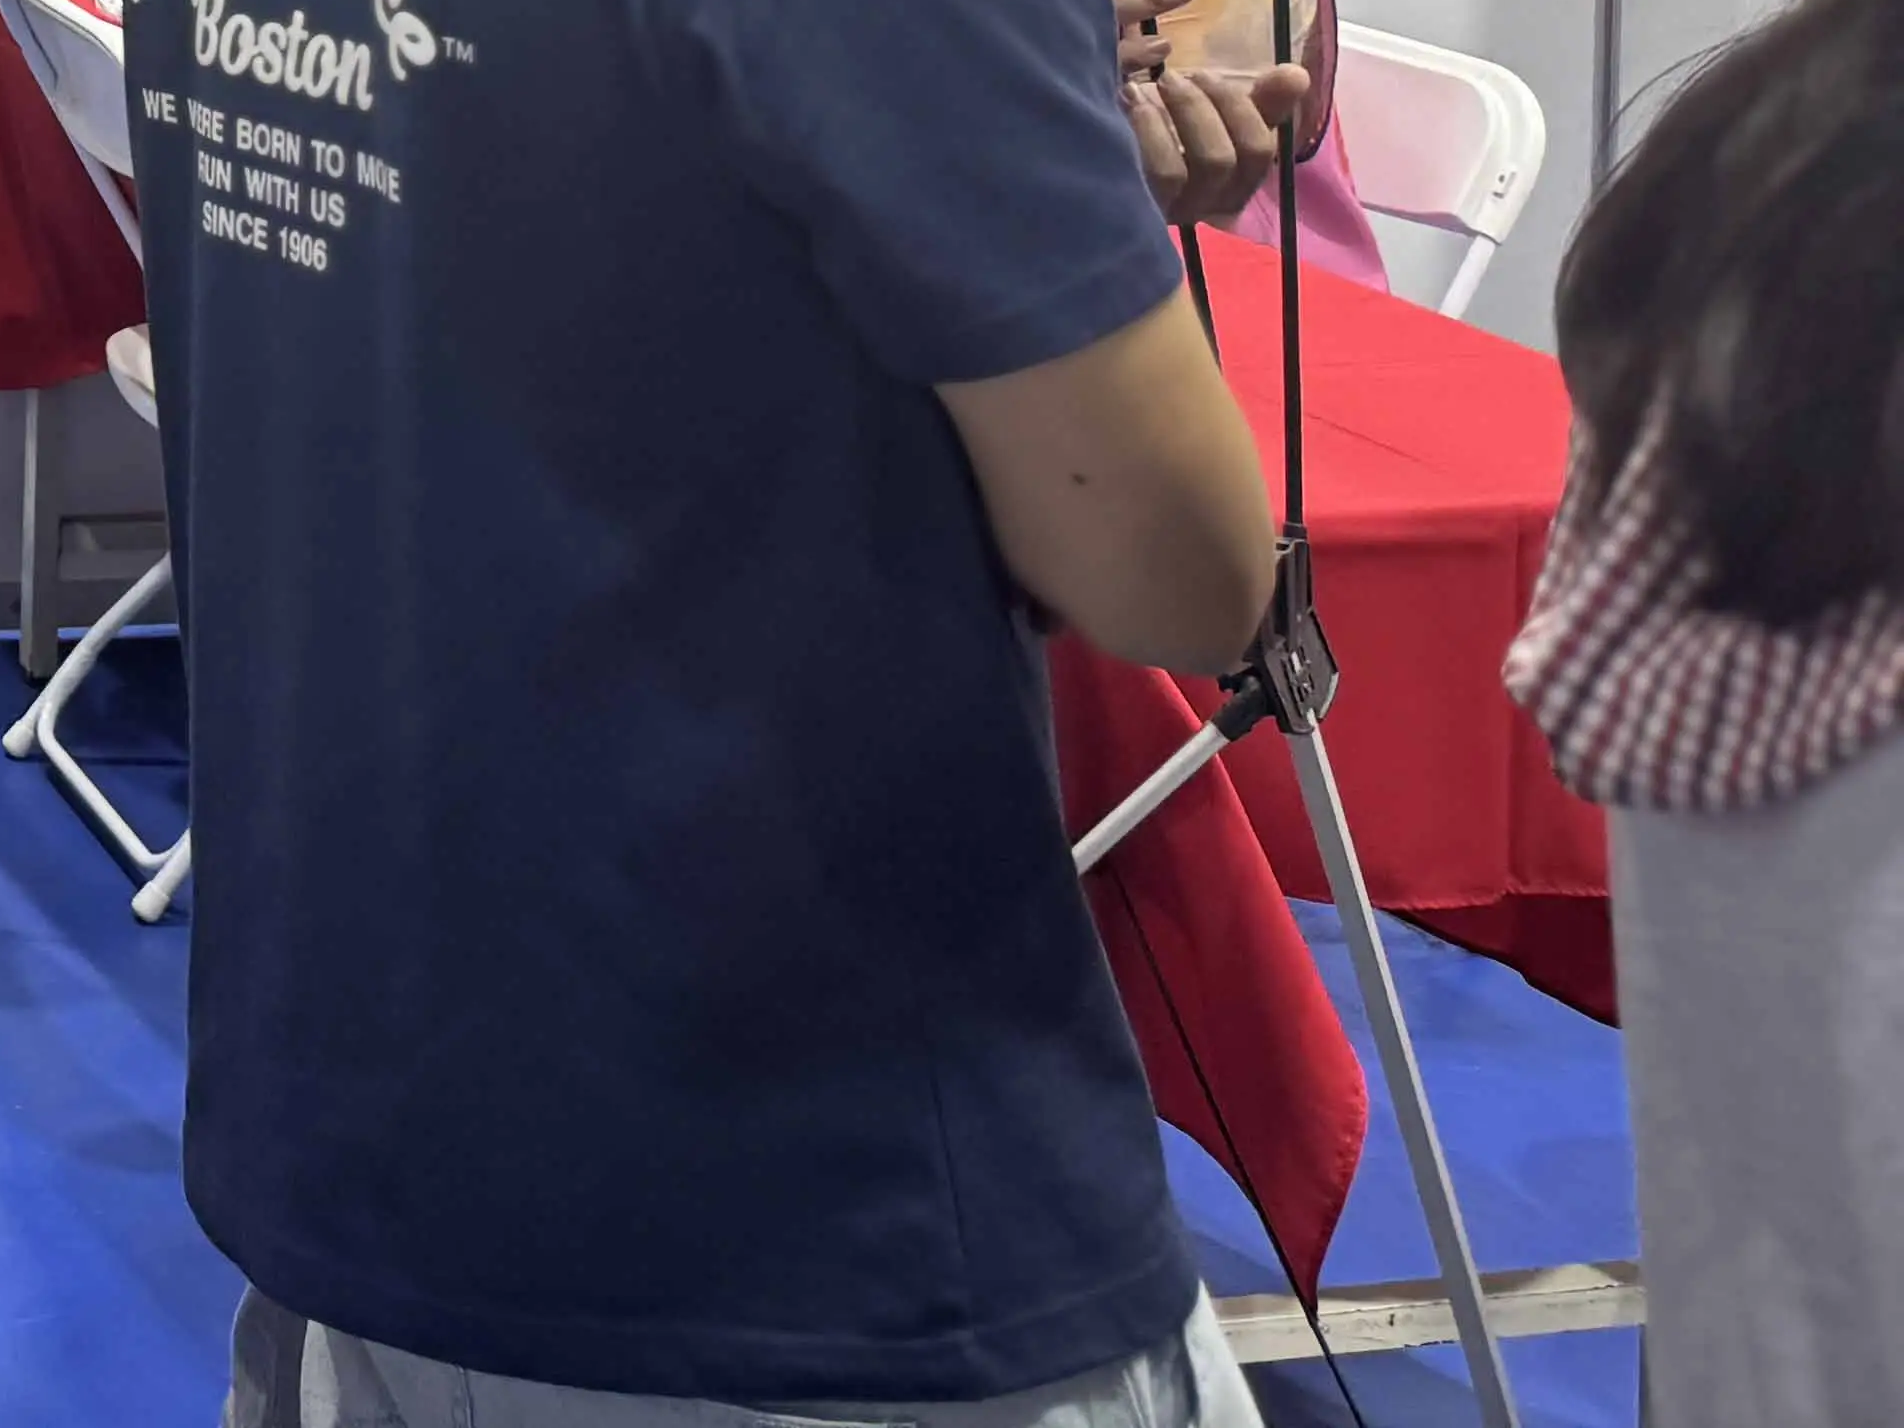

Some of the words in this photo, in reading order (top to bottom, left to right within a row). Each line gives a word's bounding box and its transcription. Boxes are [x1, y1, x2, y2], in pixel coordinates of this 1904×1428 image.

[142, 88, 178, 125] WE
[236, 118, 301, 168] BORN
[311, 139, 345, 179] TO
[245, 167, 299, 214] WITH
[311, 189, 346, 228] US
[202, 200, 268, 251] SINCE
[279, 226, 328, 271] 1906
